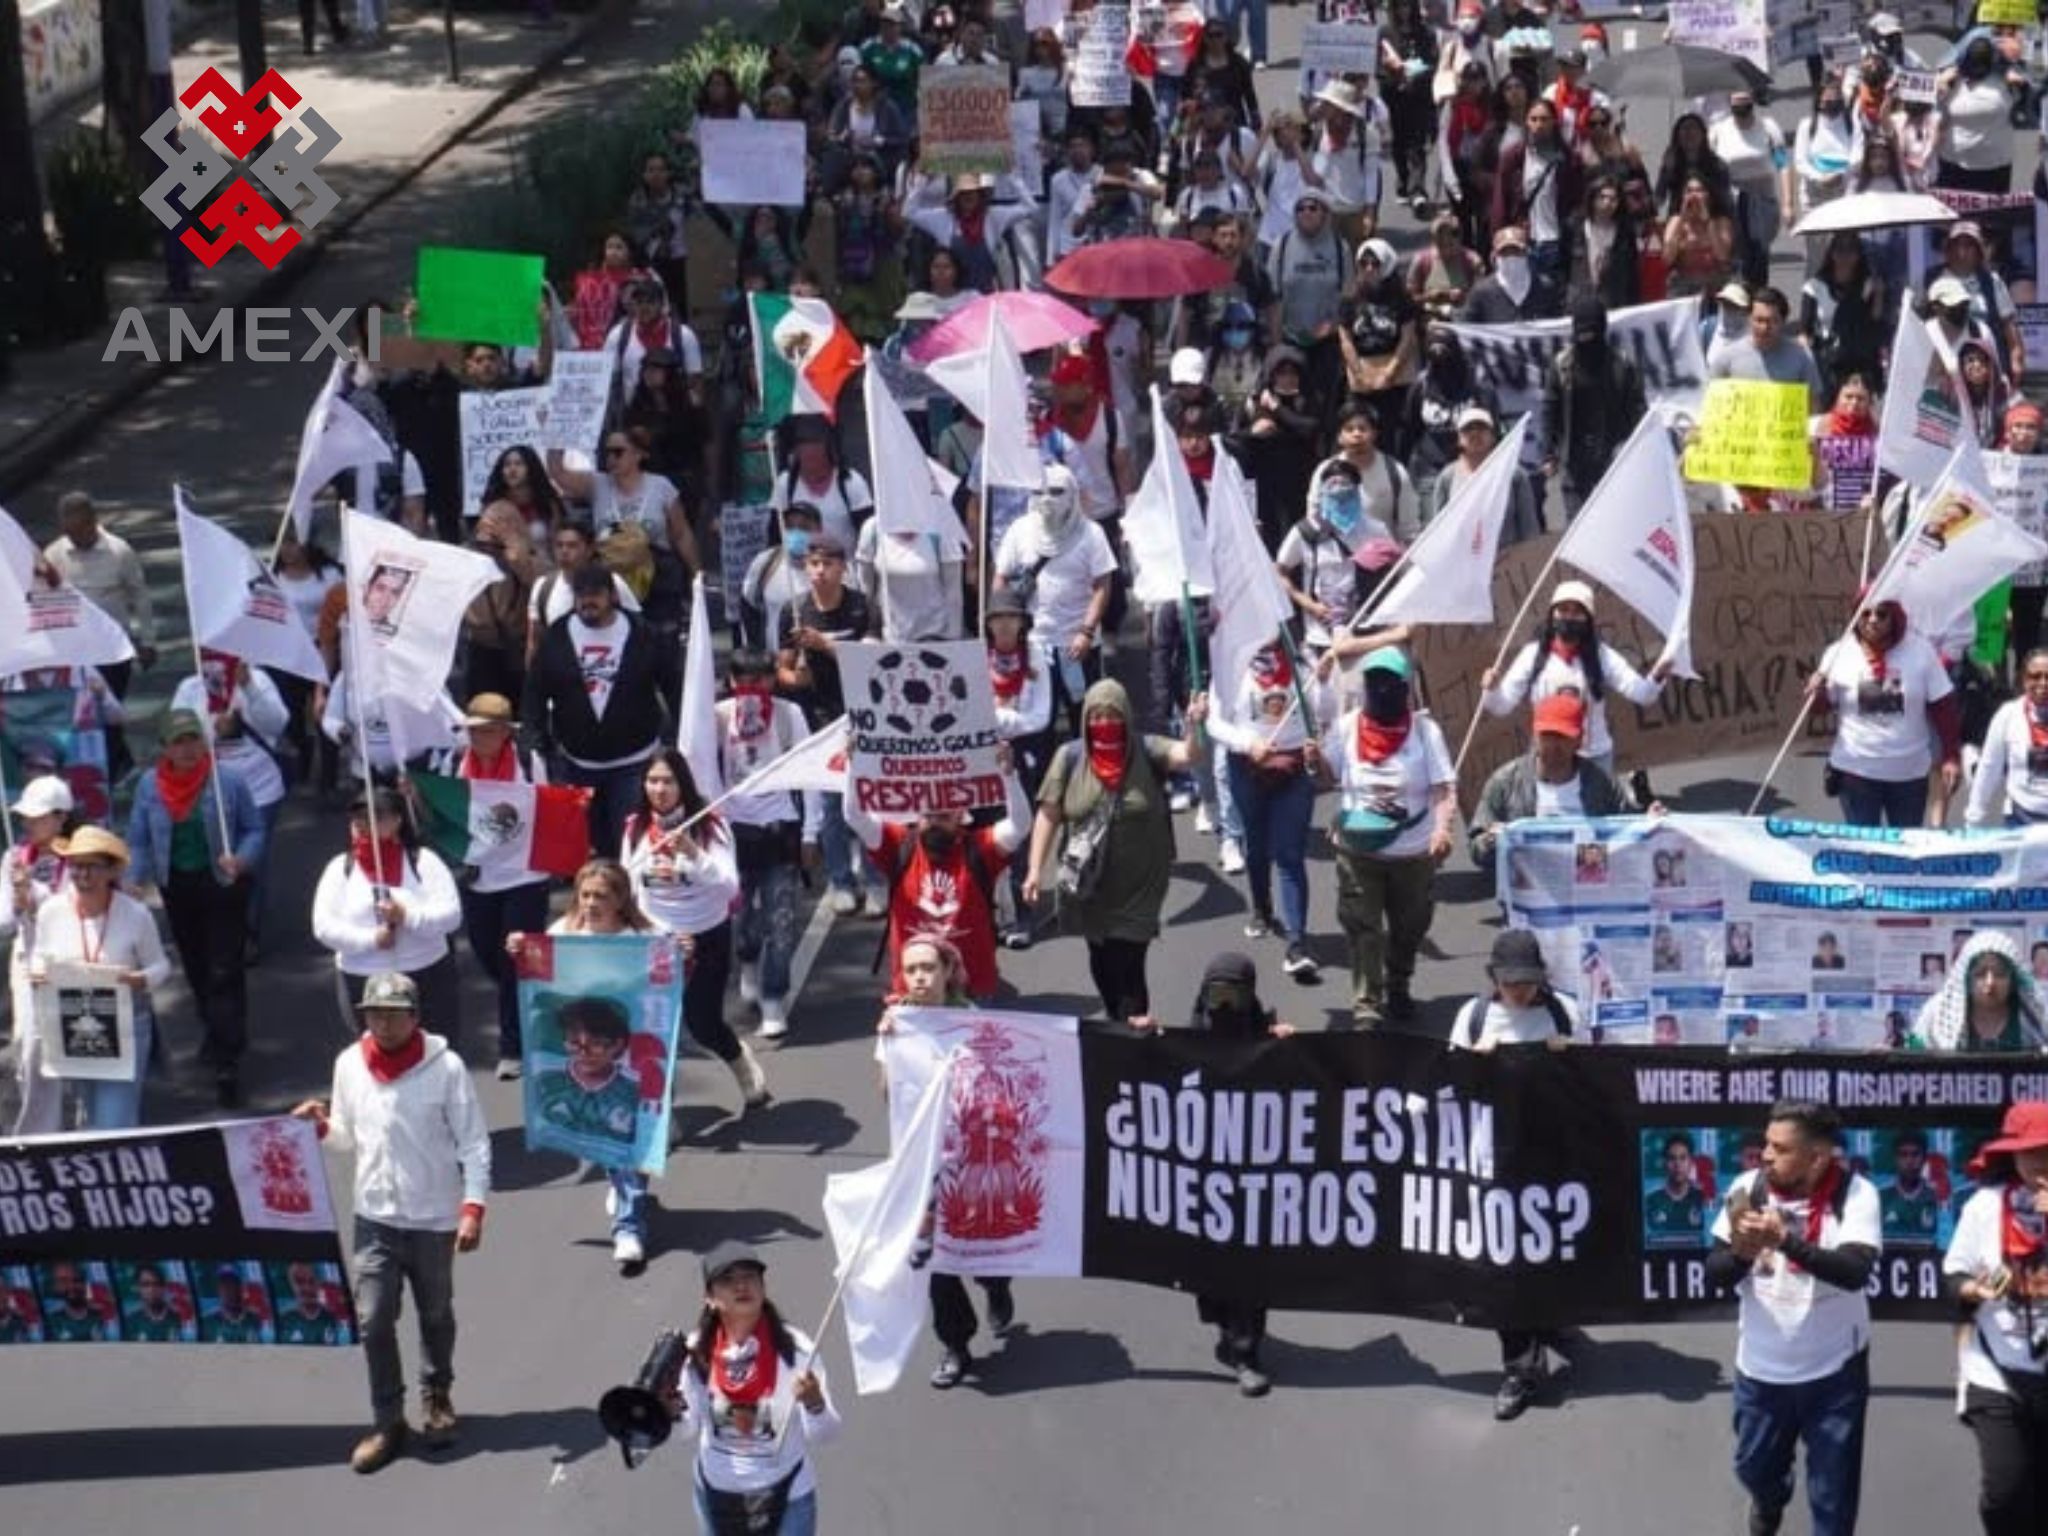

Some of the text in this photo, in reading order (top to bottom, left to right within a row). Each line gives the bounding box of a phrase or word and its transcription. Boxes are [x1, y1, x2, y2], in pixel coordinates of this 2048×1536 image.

[849, 708, 877, 731] NO
[857, 729, 999, 755] QUEREMOS GOLES
[881, 756, 967, 776] QUEREMOS
[855, 773, 1007, 813] RESPUESTA
[1636, 1069, 1720, 1104] WHERE
[1728, 1069, 1775, 1104] ARE
[1782, 1069, 1830, 1102] OUR
[1837, 1071, 2003, 1107] DISAPPEARED
[1105, 1071, 1494, 1180] ¿DÓNDE ESTÁN
[82, 1184, 214, 1228] HIJOS?
[1107, 1148, 1590, 1266] NUESTROS HIJOS?
